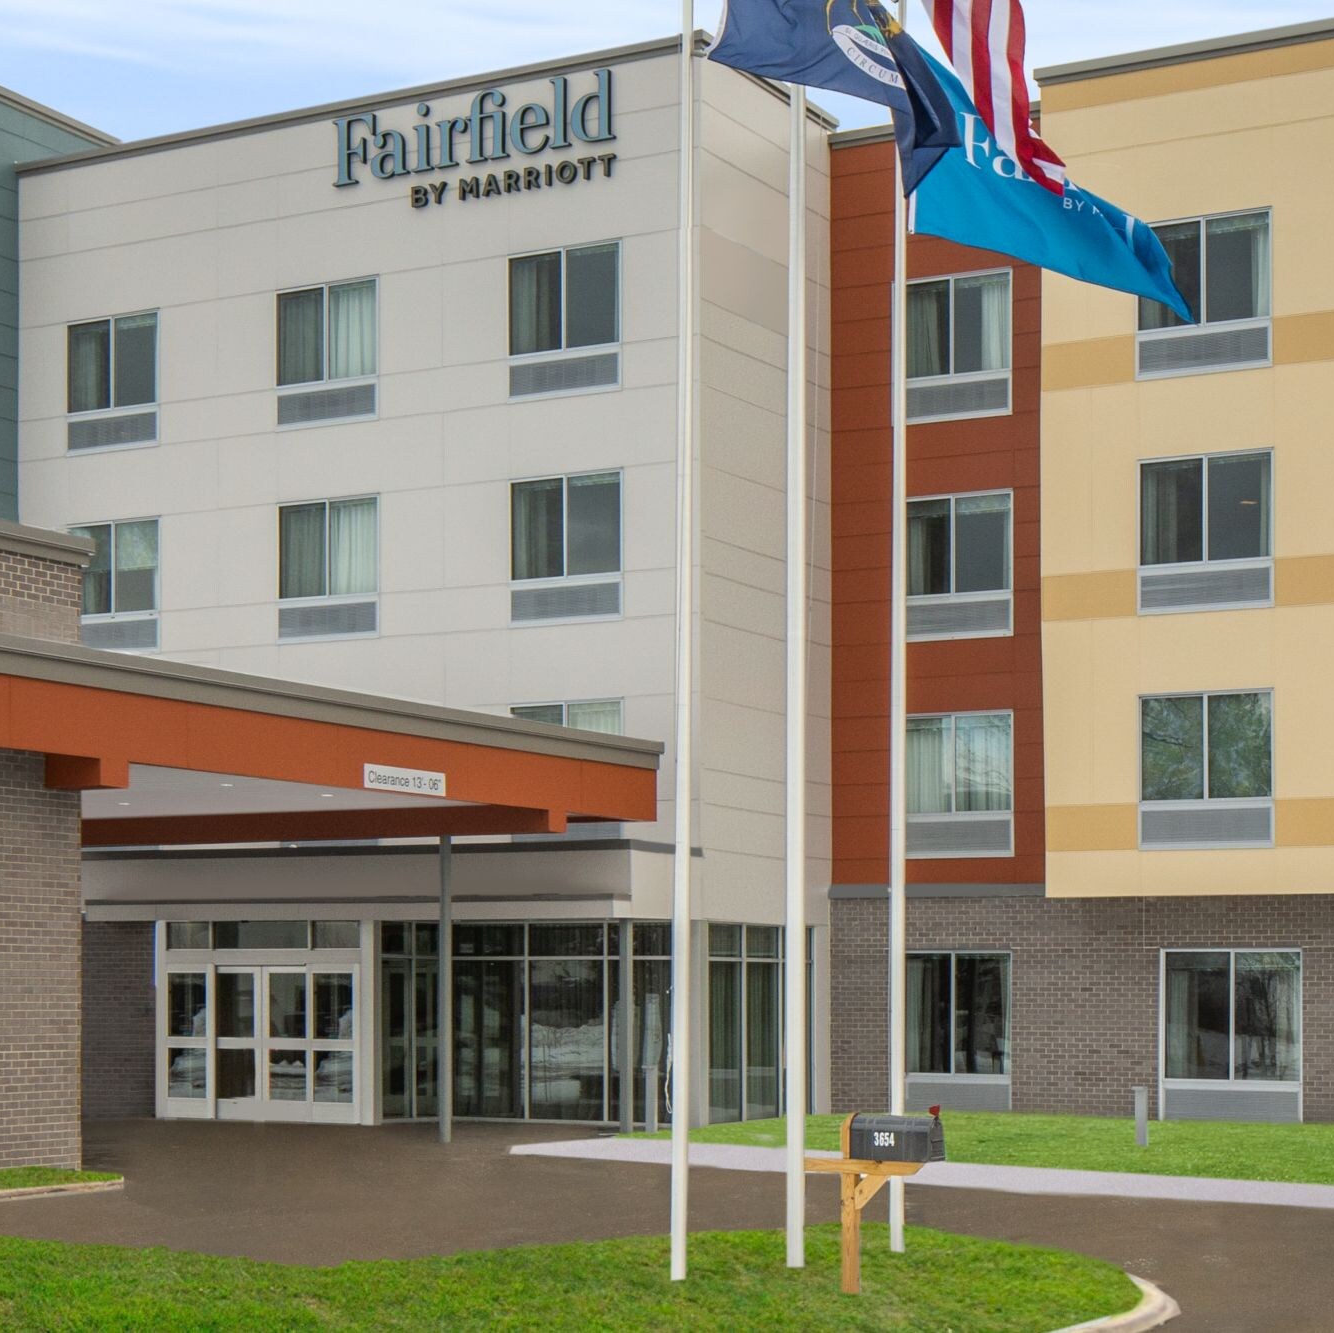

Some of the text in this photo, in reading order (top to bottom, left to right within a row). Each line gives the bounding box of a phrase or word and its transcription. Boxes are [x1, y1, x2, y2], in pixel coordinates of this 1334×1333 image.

[332, 68, 616, 188] Fairfield
[411, 153, 617, 208] BY MARRIOTT
[1063, 197, 1085, 212] BY
[368, 770, 410, 788] Clearance
[873, 1132, 895, 1147] 3654
